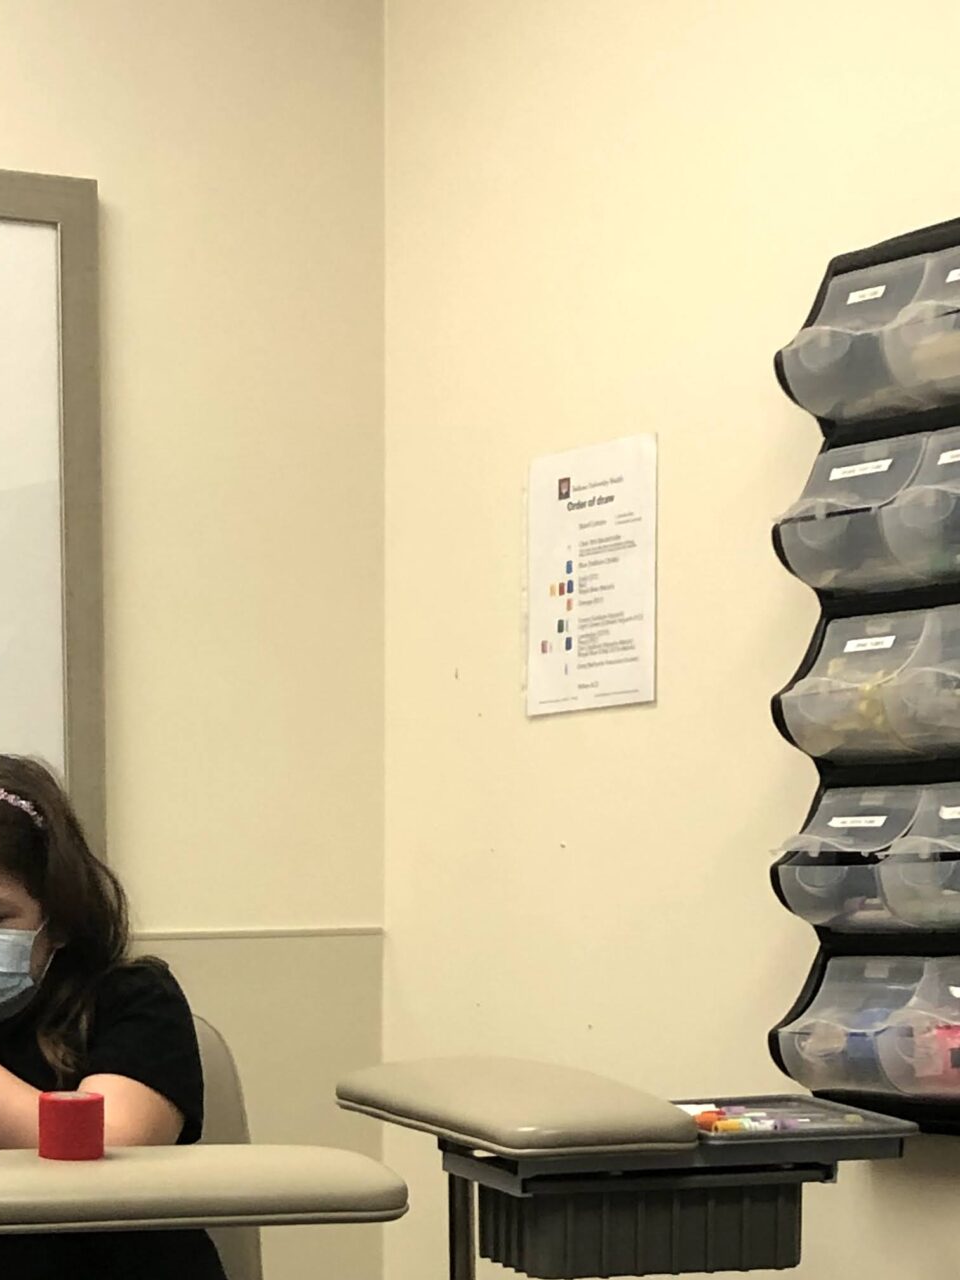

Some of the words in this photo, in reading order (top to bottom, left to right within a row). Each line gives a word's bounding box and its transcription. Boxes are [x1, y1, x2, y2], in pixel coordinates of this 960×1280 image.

[566, 499, 586, 512] Order
[587, 495, 596, 508] of
[596, 494, 615, 506] draw
